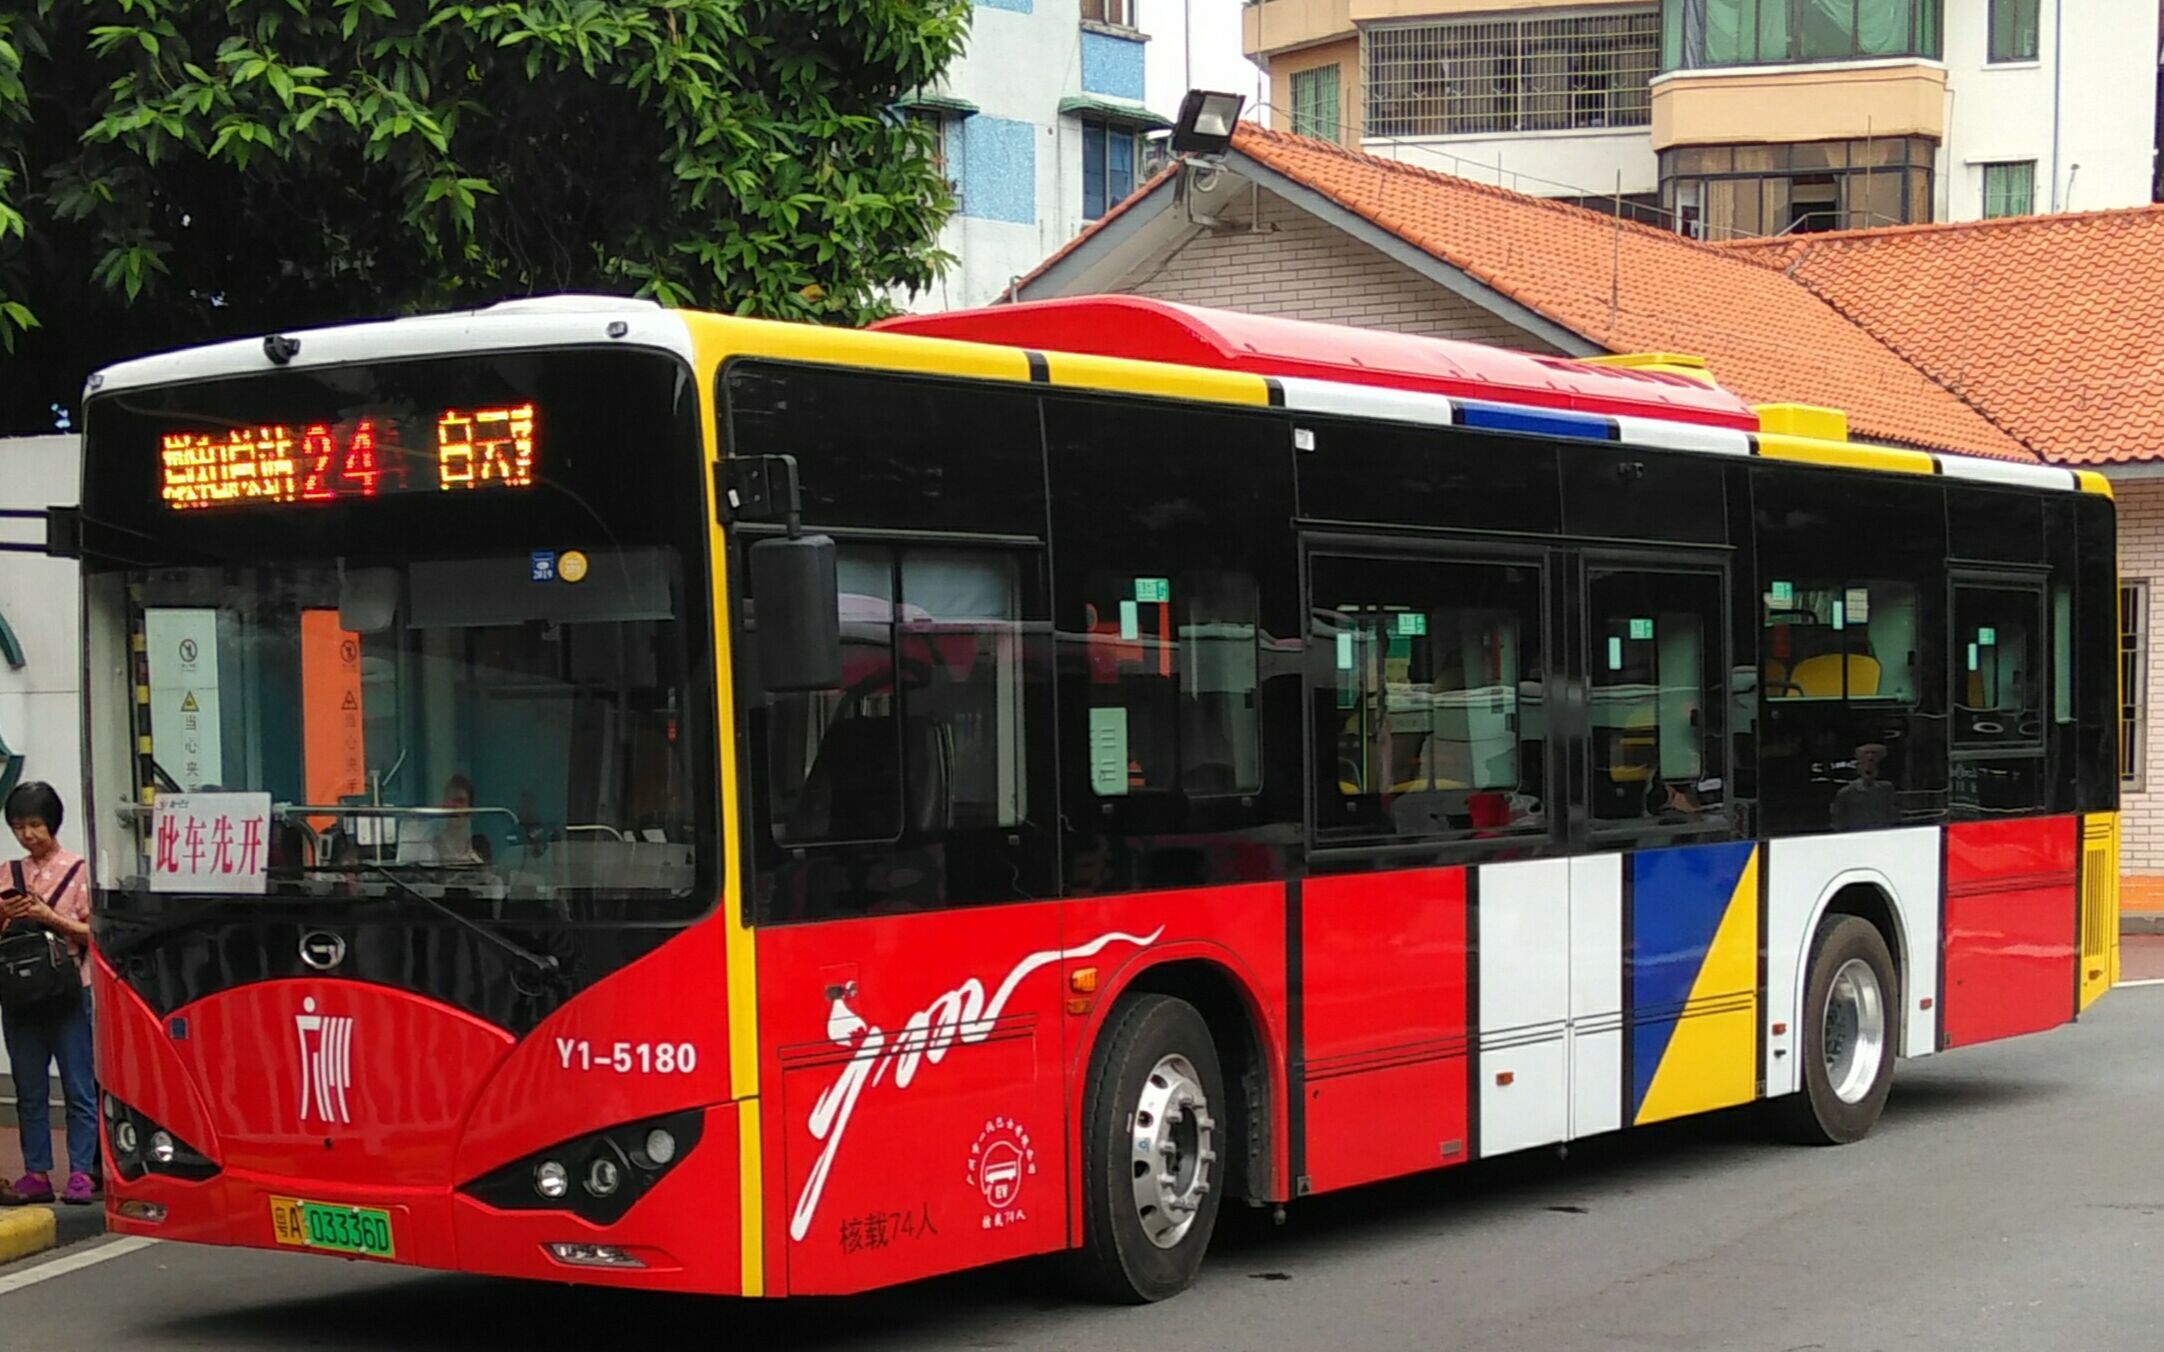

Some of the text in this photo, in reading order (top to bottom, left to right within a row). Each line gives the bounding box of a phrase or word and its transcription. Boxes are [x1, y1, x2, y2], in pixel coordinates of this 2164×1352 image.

[302, 417, 379, 502] 24
[156, 814, 264, 875] 此车先开
[555, 1037, 697, 1074] Y1-5180
[995, 1184, 1008, 1200] EV
[839, 1202, 938, 1256] 核载74人
